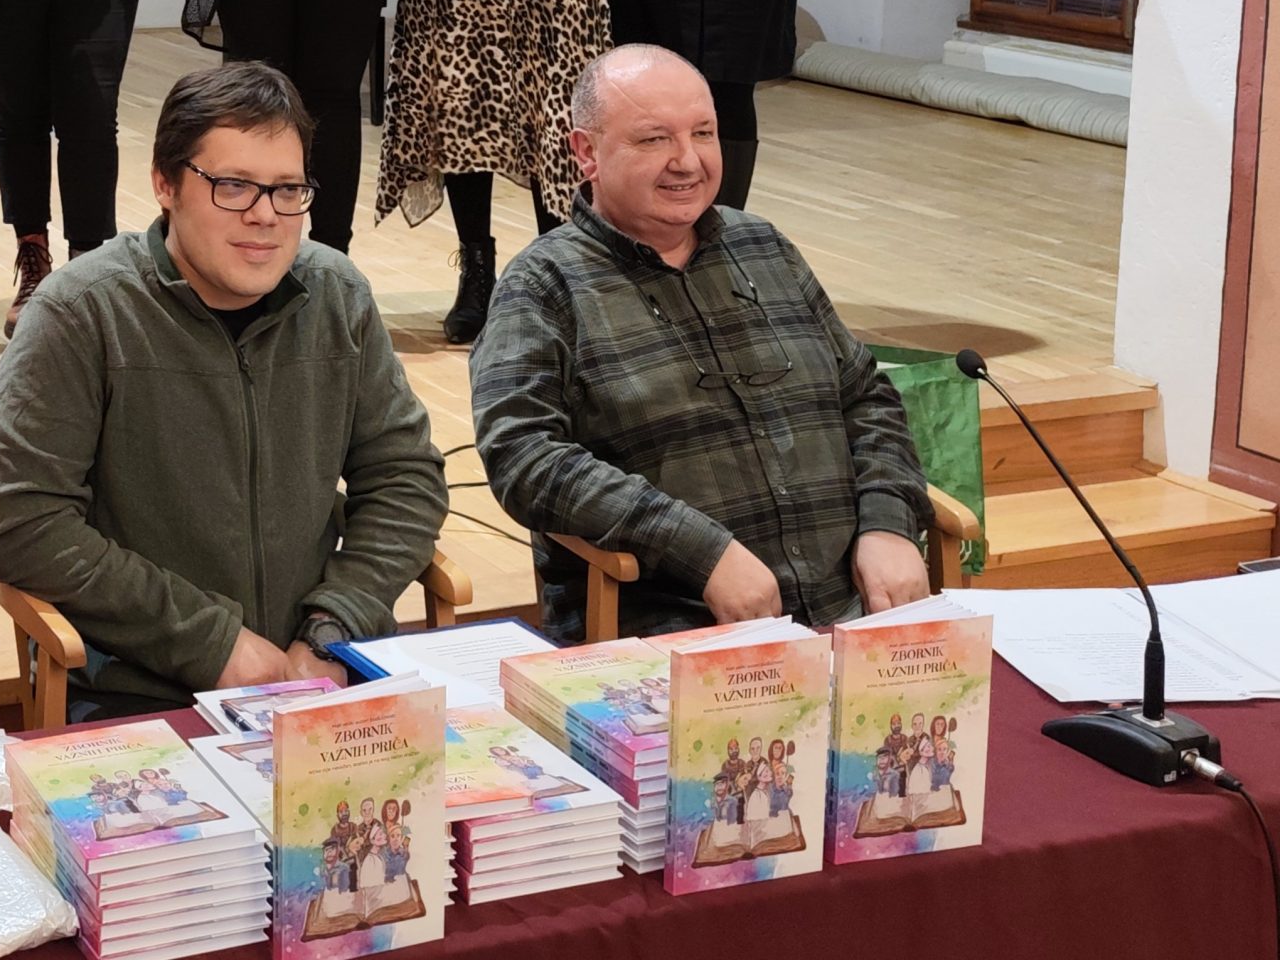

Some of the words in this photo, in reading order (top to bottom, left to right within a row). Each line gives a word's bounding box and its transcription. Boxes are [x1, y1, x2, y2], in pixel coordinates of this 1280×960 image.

[890, 645, 944, 662] ZBORNIK
[923, 659, 958, 674] PRIČA
[727, 667, 782, 685] ZBORNIK
[761, 681, 796, 697] PRIČA
[333, 722, 393, 744] ZBORNIK
[63, 737, 122, 752] ZBORNIK
[105, 742, 144, 753] PRIČA
[320, 745, 367, 762] VAŽNIH
[371, 736, 409, 754] PRIČA
